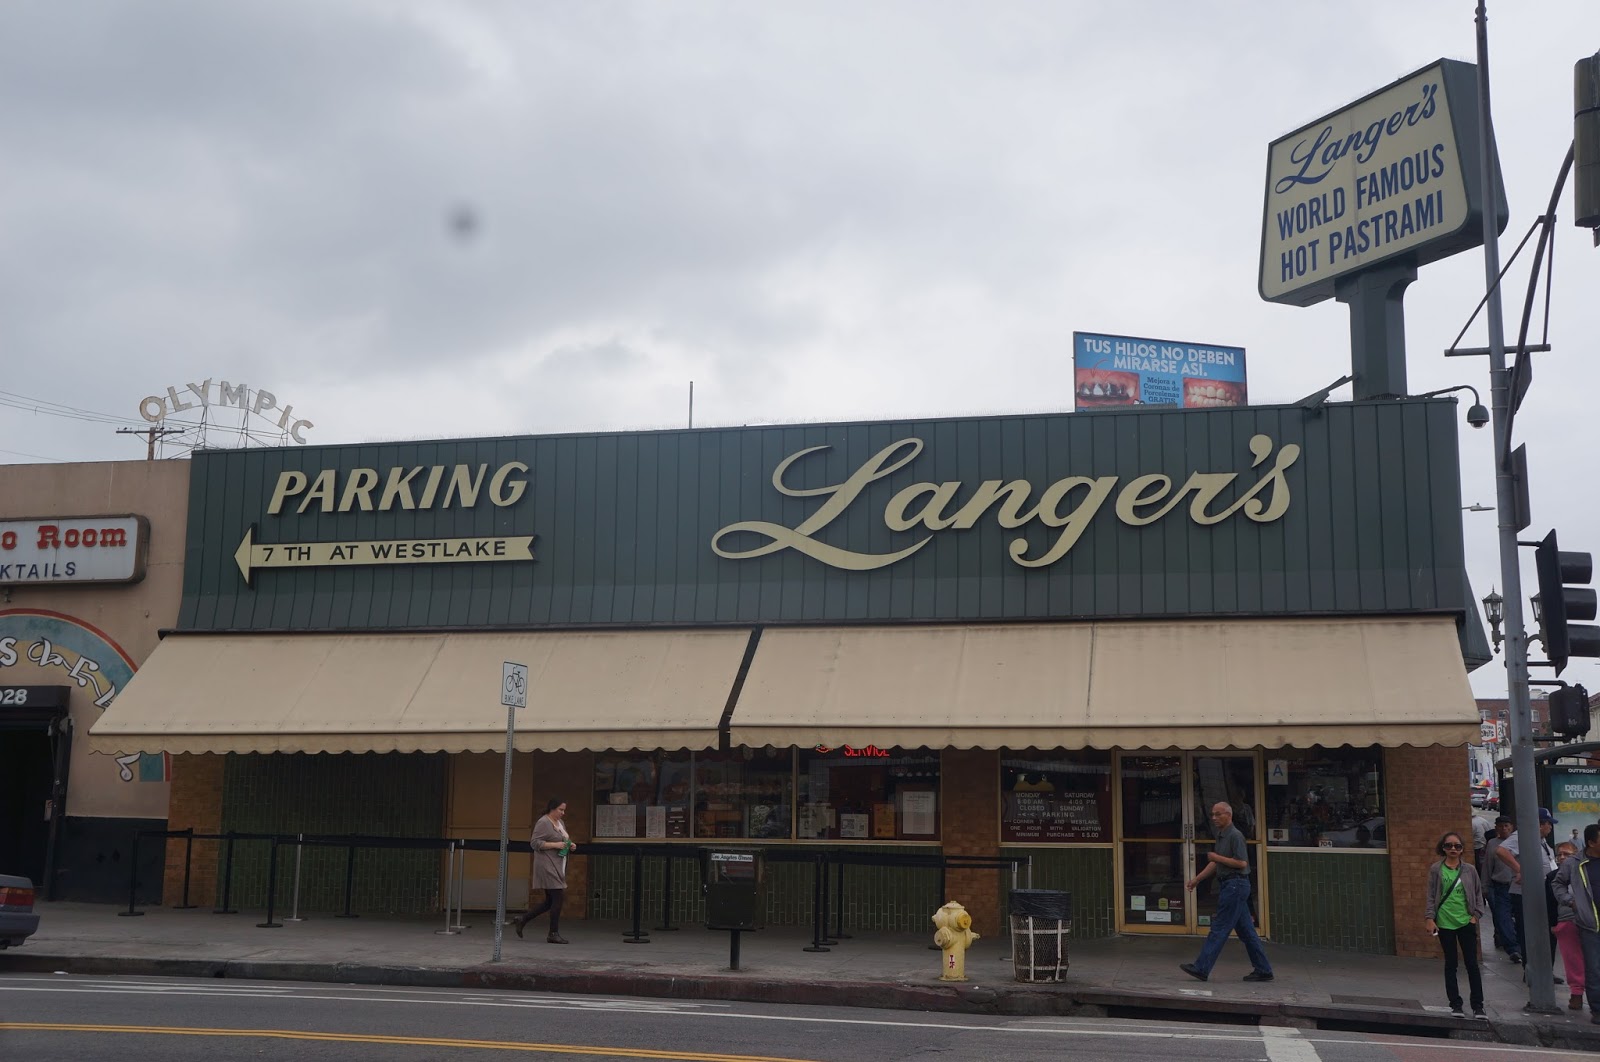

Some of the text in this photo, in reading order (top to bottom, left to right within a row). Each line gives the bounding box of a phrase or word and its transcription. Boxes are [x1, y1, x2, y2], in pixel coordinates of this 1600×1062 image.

[1275, 83, 1438, 194] Langer's
[1277, 143, 1445, 241] WORLD FAMOUS
[1281, 190, 1443, 283] HOT PASTRAMI
[1084, 339, 1235, 365] TUS HIJOS NO DEBEN
[1113, 356, 1177, 373] MIRARSE
[1143, 383, 1171, 391] Coronas
[1147, 377, 1170, 385] Mejora
[139, 377, 314, 445] OLYMPIC
[266, 461, 530, 514] PARKING
[711, 434, 1301, 571] Langer's
[37, 525, 128, 549] Room
[262, 541, 506, 561] 7 TH AT WESTLAKE
[1273, 764, 1284, 777] A
[1564, 784, 1598, 792] DREAM
